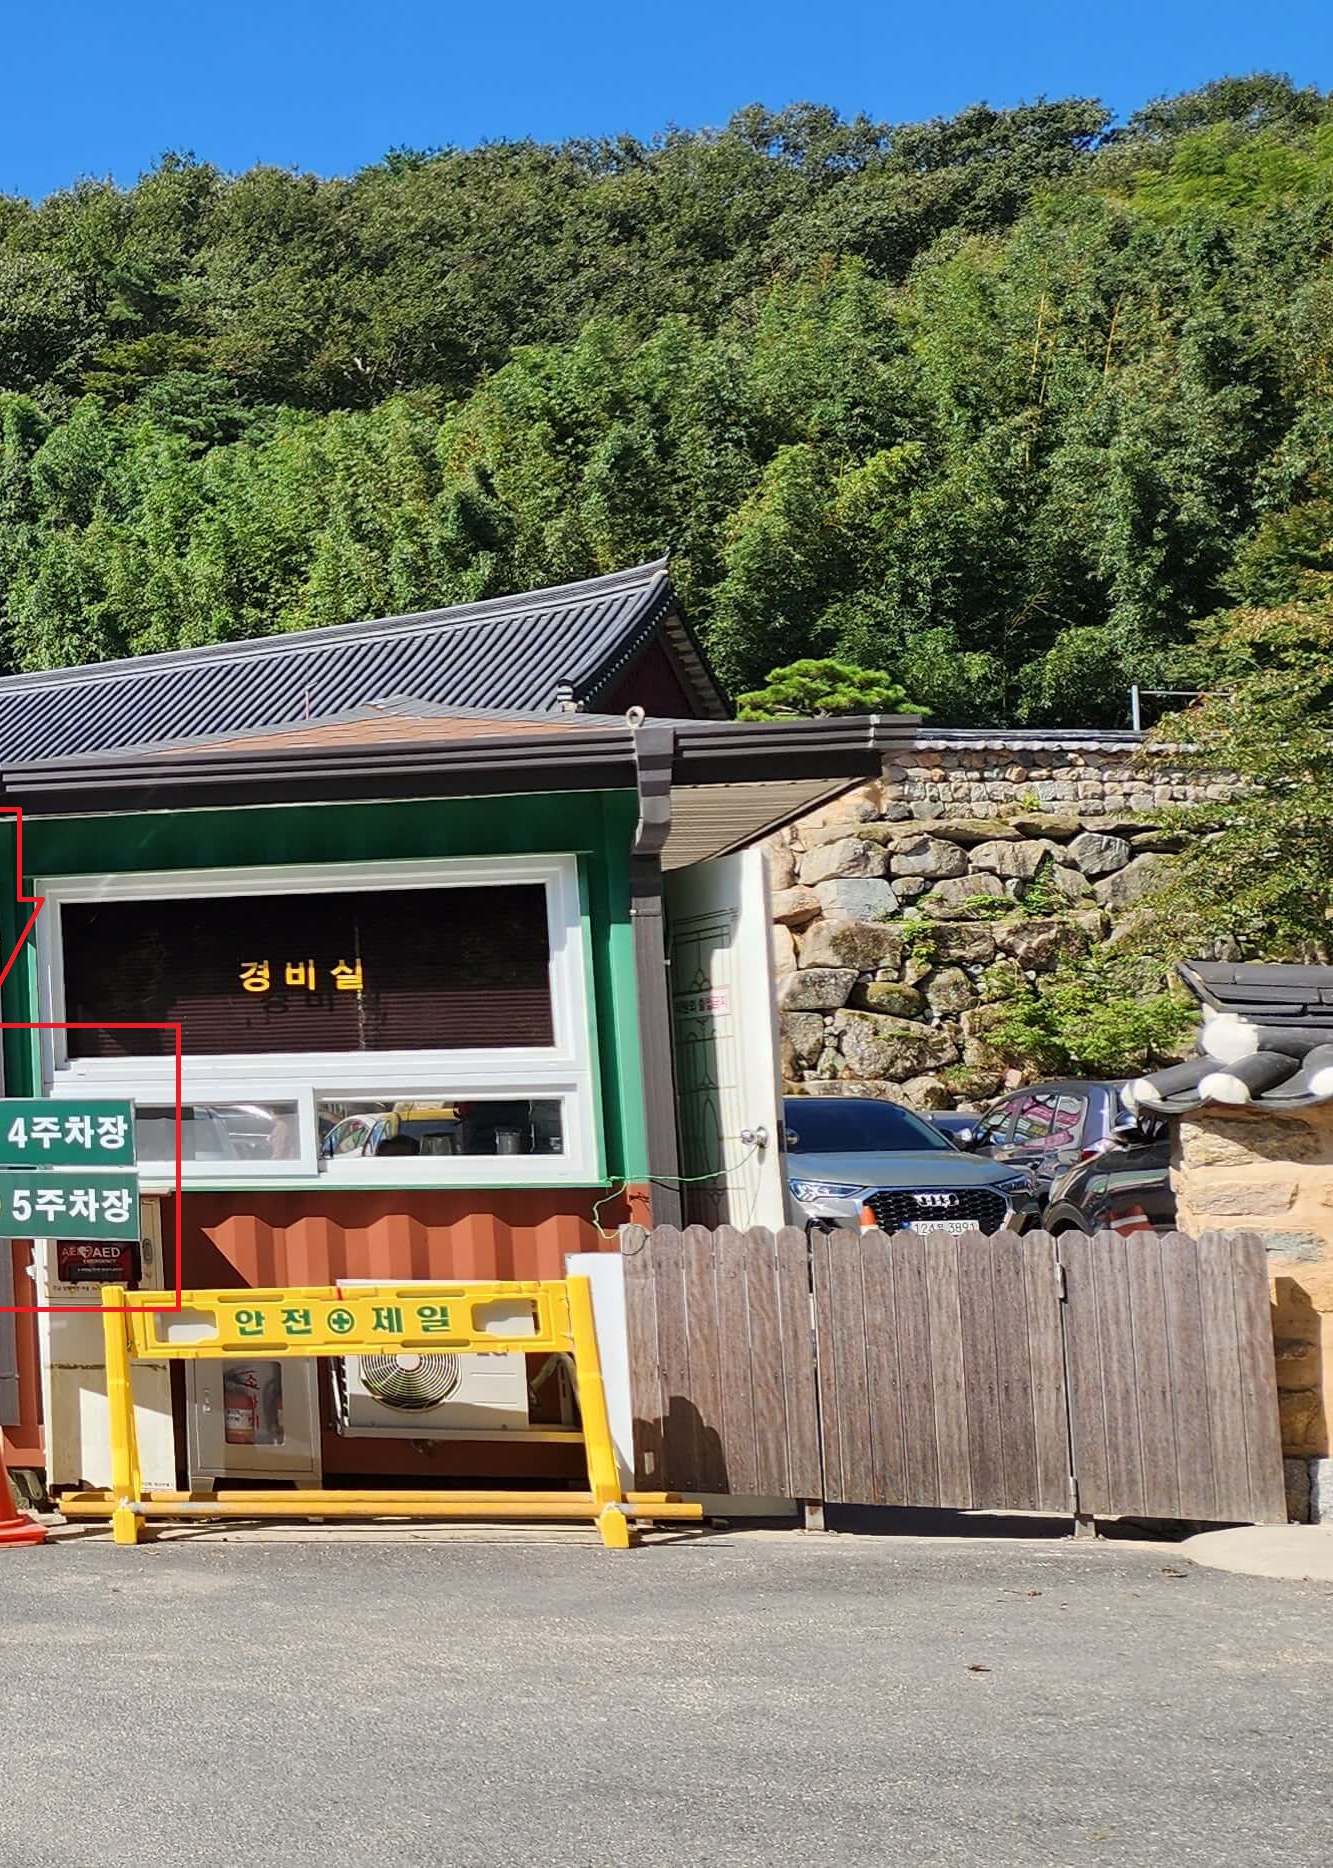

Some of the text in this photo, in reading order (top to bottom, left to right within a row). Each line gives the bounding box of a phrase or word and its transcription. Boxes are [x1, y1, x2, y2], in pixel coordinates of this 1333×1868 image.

[238, 958, 364, 992] 경비실
[7, 1114, 128, 1149] 4주차장
[12, 1188, 133, 1223] 5주차장
[93, 1247, 121, 1258] AED
[234, 1305, 451, 1336] 안전 제일
